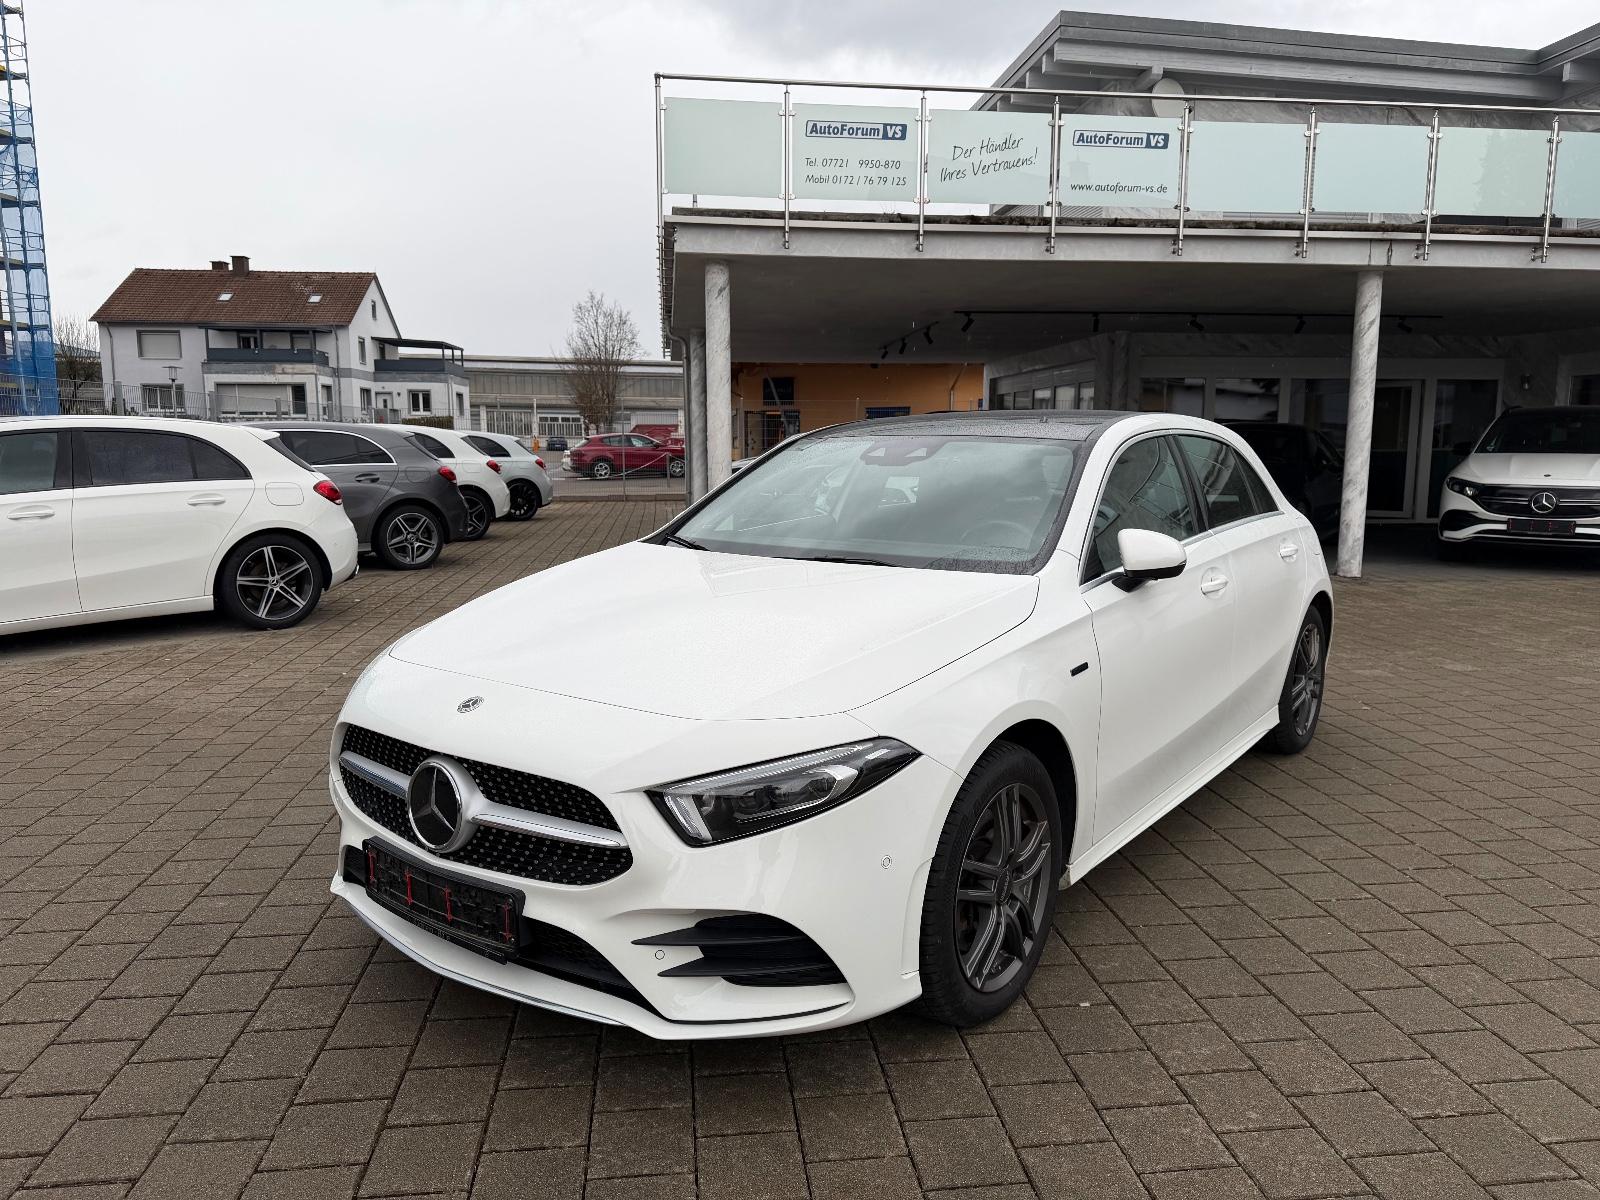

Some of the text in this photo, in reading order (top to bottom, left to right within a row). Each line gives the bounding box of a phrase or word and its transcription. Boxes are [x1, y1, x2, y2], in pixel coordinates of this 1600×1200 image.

[809, 123, 902, 138] AutoForum VS
[952, 133, 1023, 161] Der Händler
[1076, 132, 1165, 147] AutoForum VS
[805, 157, 901, 170] Tel. 07721 9950-870
[940, 149, 1039, 183] Ihres Vertrauens!
[805, 174, 830, 184] Mobil
[832, 175, 854, 185] 0172
[863, 176, 874, 186] 76
[876, 176, 887, 186] 79
[891, 176, 907, 187] 125
[1070, 182, 1168, 195] www.autoforum-vs.de
